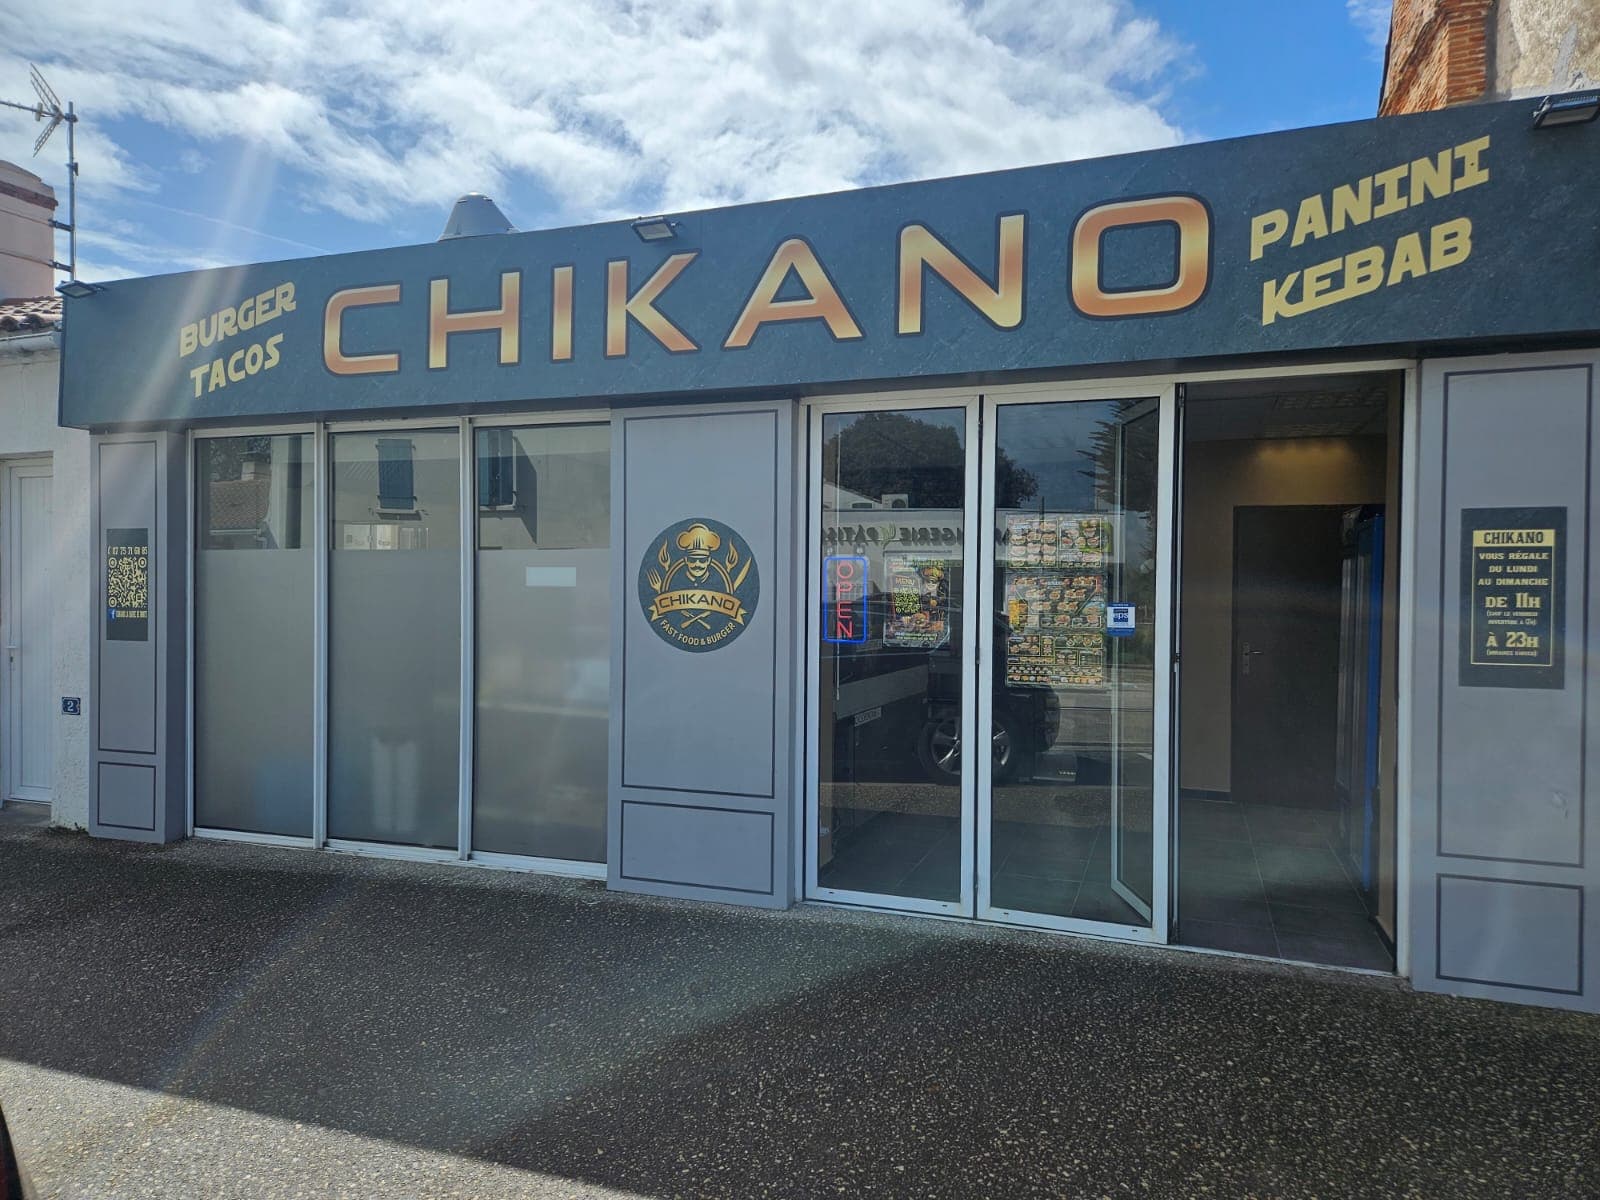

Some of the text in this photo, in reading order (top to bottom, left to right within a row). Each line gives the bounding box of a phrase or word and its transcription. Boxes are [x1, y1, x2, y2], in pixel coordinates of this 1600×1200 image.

[1250, 134, 1491, 262] PANINI
[1261, 216, 1473, 327] KEBAB
[322, 195, 1211, 376] CHIKANO
[180, 281, 297, 358] BURGER
[190, 332, 284, 398] TACOS
[1483, 531, 1544, 544] CHIKANO
[1479, 550, 1550, 560] VOUS RÉGALE
[1488, 565, 1539, 573] DU LUNDI
[1477, 578, 1550, 586] AU DIMANCHE
[658, 593, 736, 612] CHIKANO
[836, 561, 854, 639] OPEN
[1484, 596, 1508, 608] DE
[660, 618, 679, 638] FAST
[678, 633, 700, 646] FOOD
[706, 622, 736, 645] BURGER
[1486, 631, 1539, 648] À 23H
[67, 700, 74, 712] 2
